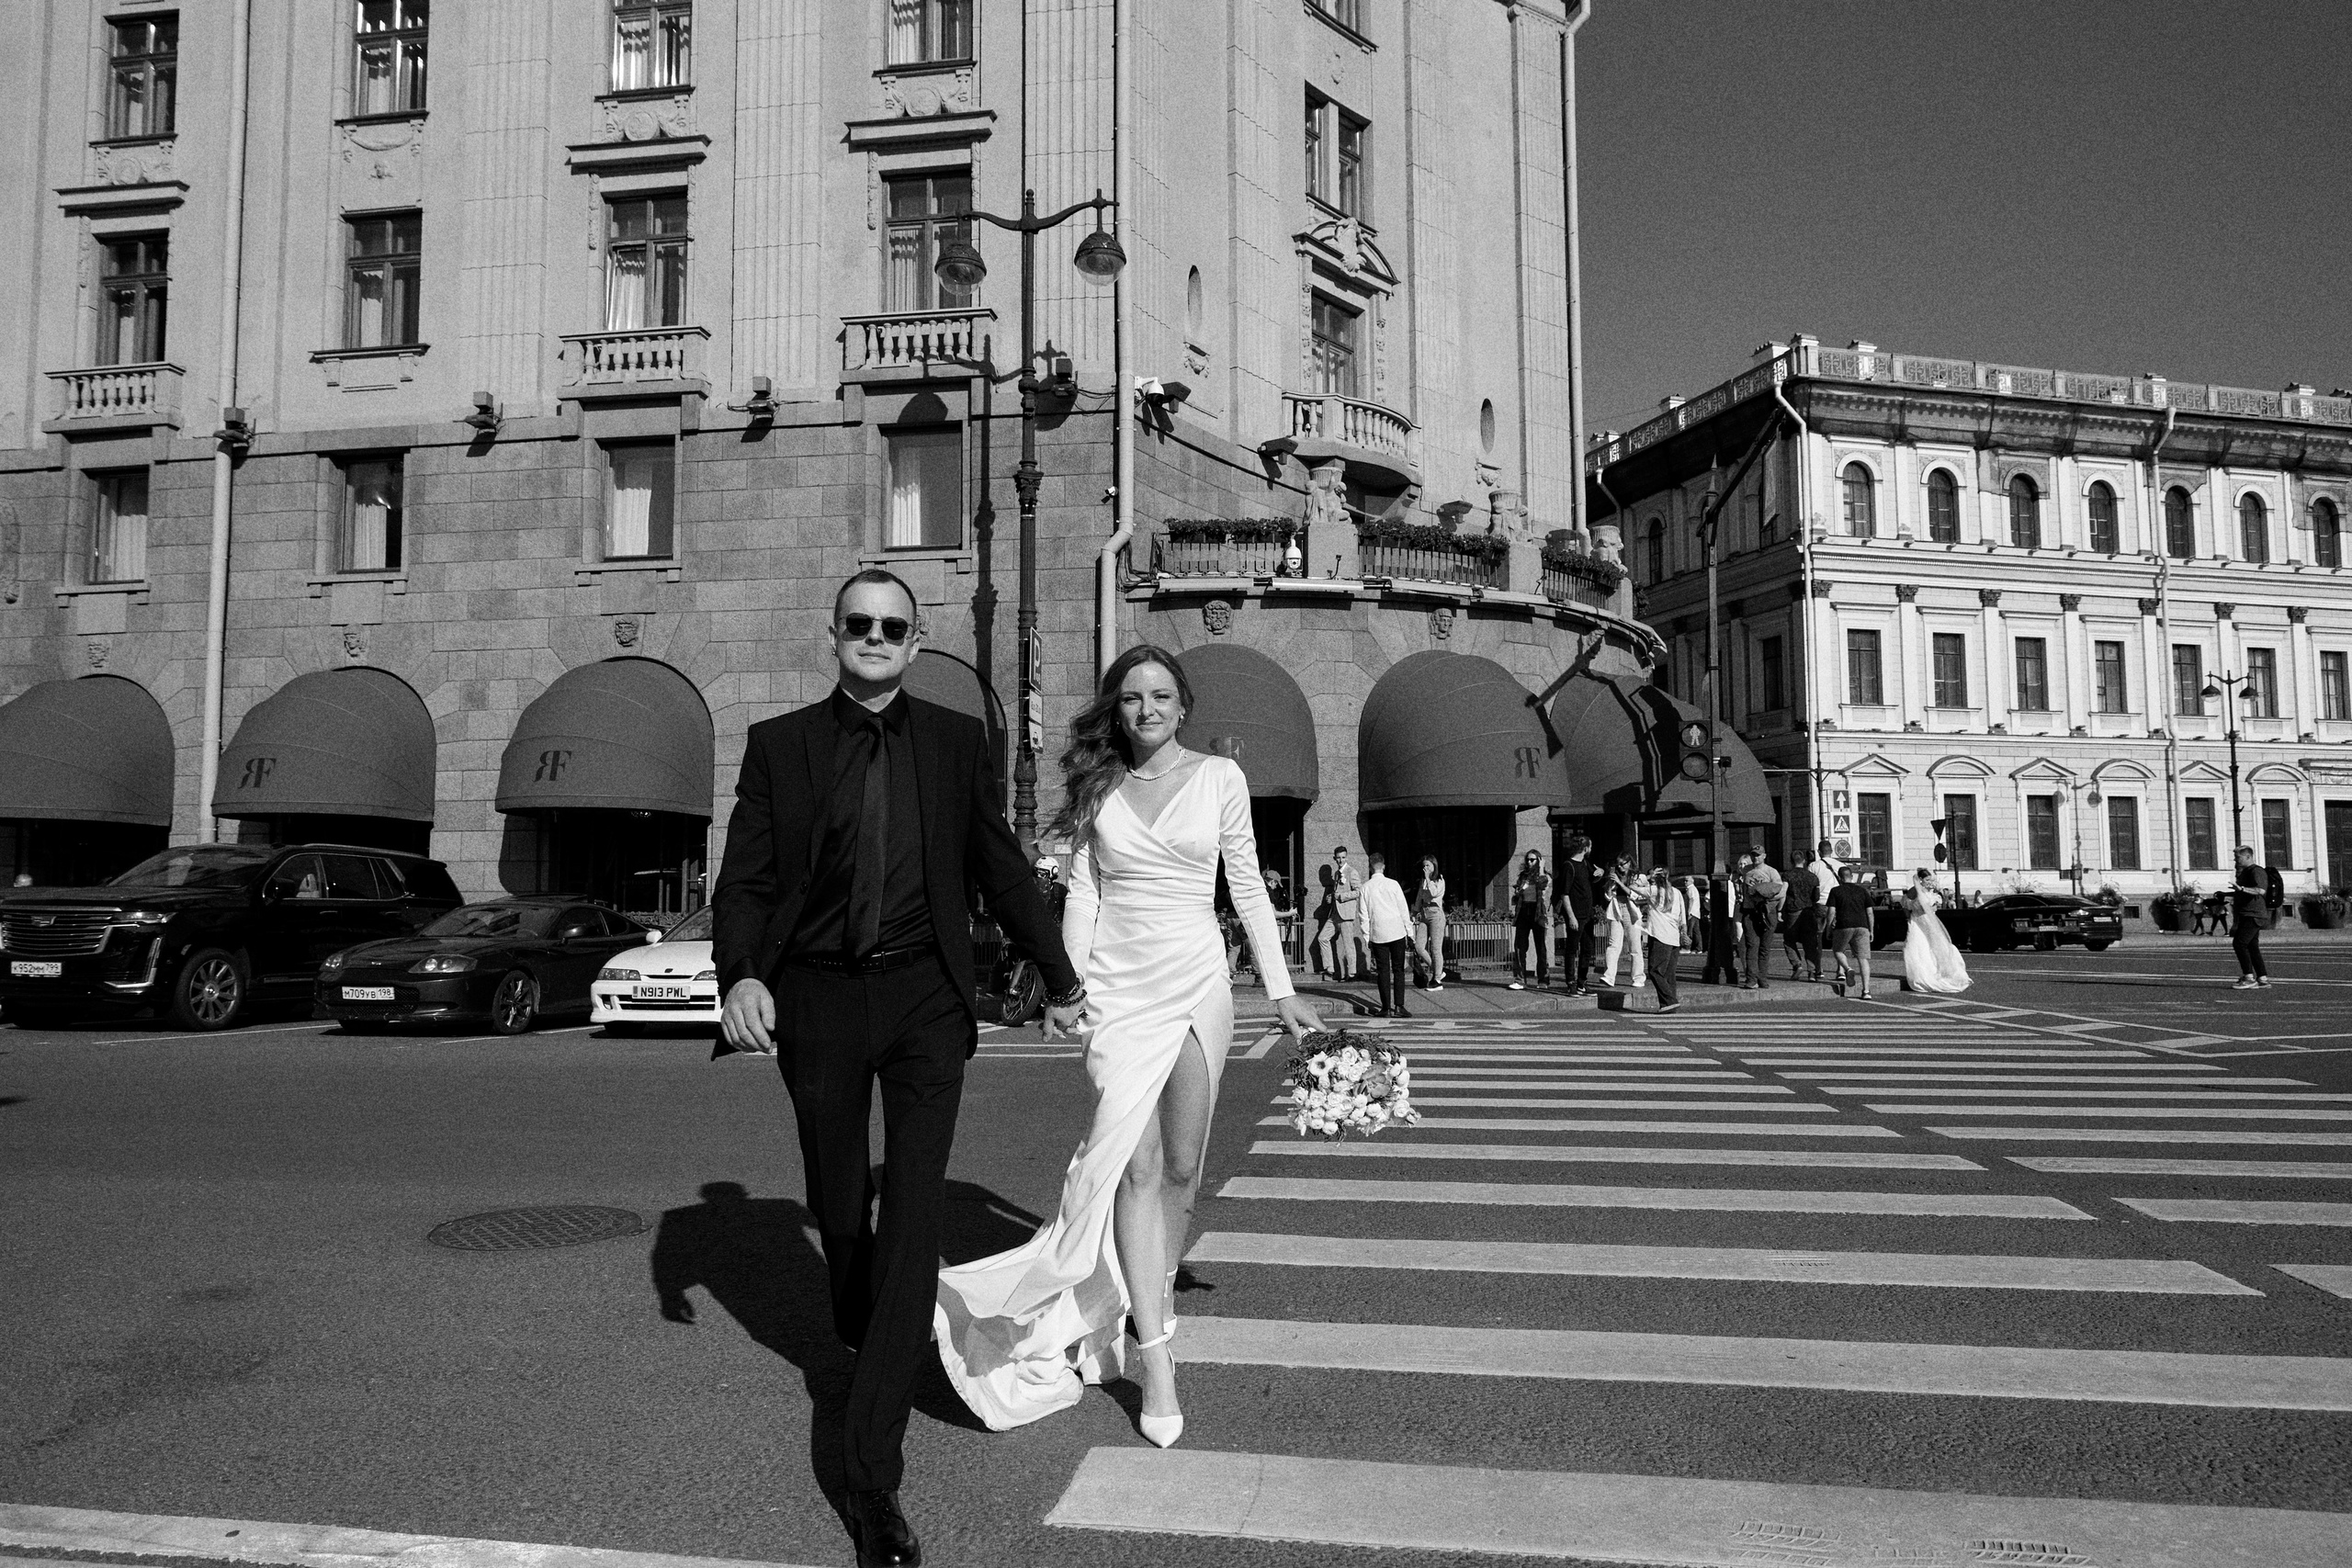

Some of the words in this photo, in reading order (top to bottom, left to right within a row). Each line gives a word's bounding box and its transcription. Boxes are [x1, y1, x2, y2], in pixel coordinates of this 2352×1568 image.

[378, 988, 391, 997] 198
[640, 987, 663, 998] N913
[666, 987, 687, 998] PWL
